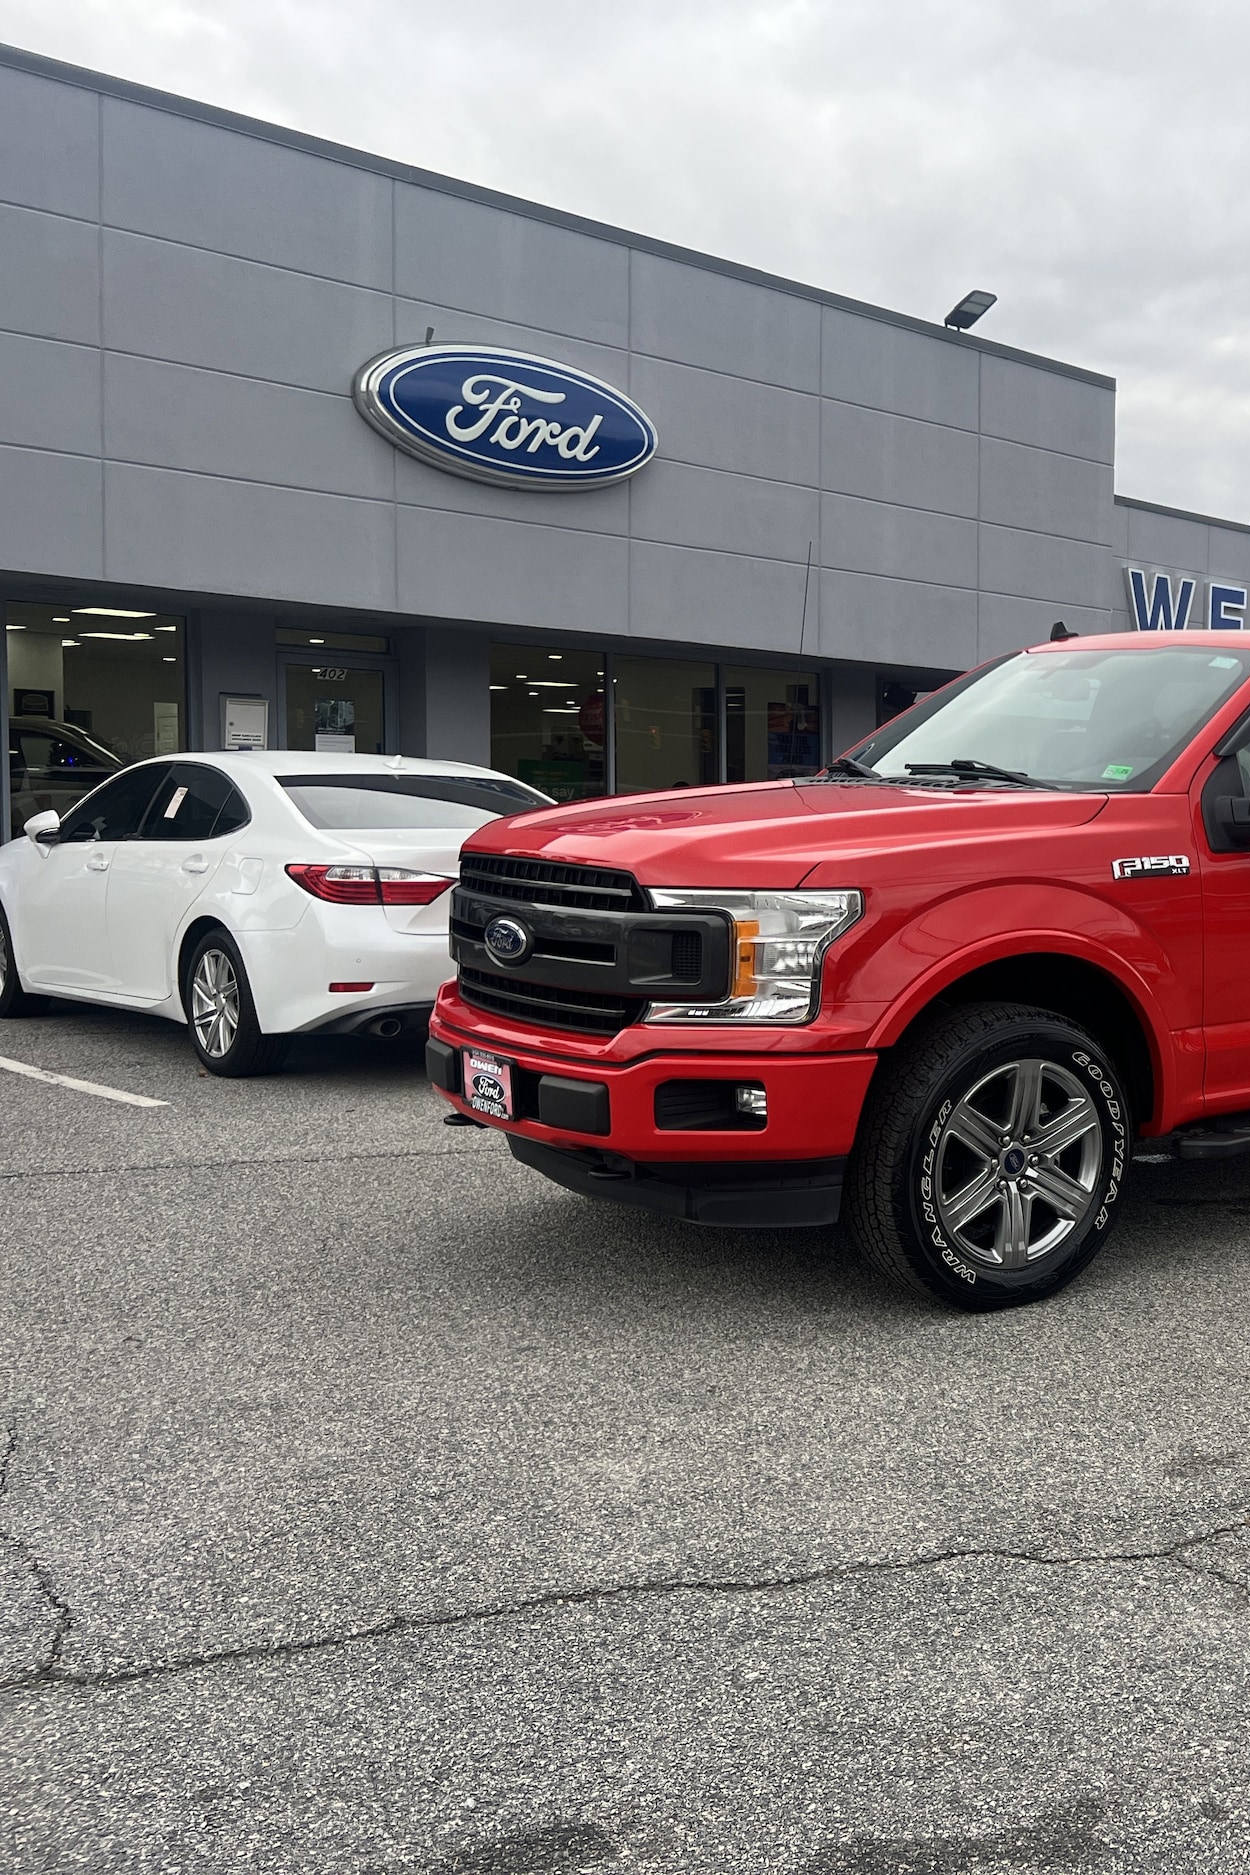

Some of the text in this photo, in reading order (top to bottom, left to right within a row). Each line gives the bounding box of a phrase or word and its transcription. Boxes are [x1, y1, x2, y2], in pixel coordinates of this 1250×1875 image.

[445, 373, 604, 463] Ford
[319, 668, 346, 680] 402
[551, 787, 575, 800] say
[490, 926, 515, 951] Ford
[478, 1076, 501, 1100] Ford
[1072, 1051, 1125, 1230] GOODYEAR
[920, 1100, 977, 1284] WRANGLER
